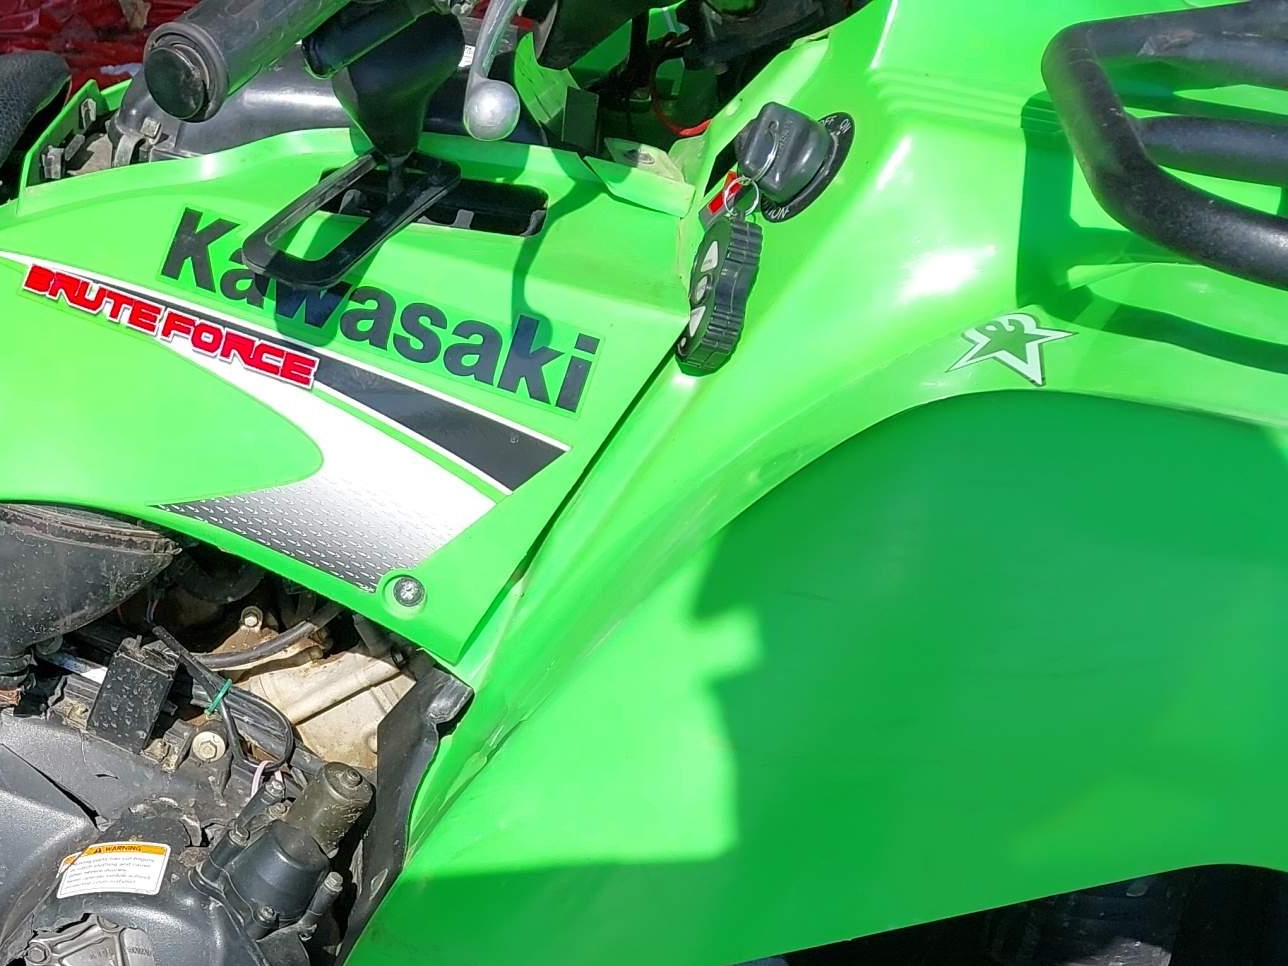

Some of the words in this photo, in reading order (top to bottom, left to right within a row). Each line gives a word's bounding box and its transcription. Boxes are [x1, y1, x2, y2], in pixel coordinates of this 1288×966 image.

[23, 263, 160, 333] BRUTE
[160, 310, 319, 388] FORCE
[160, 208, 600, 413] Kawasaki
